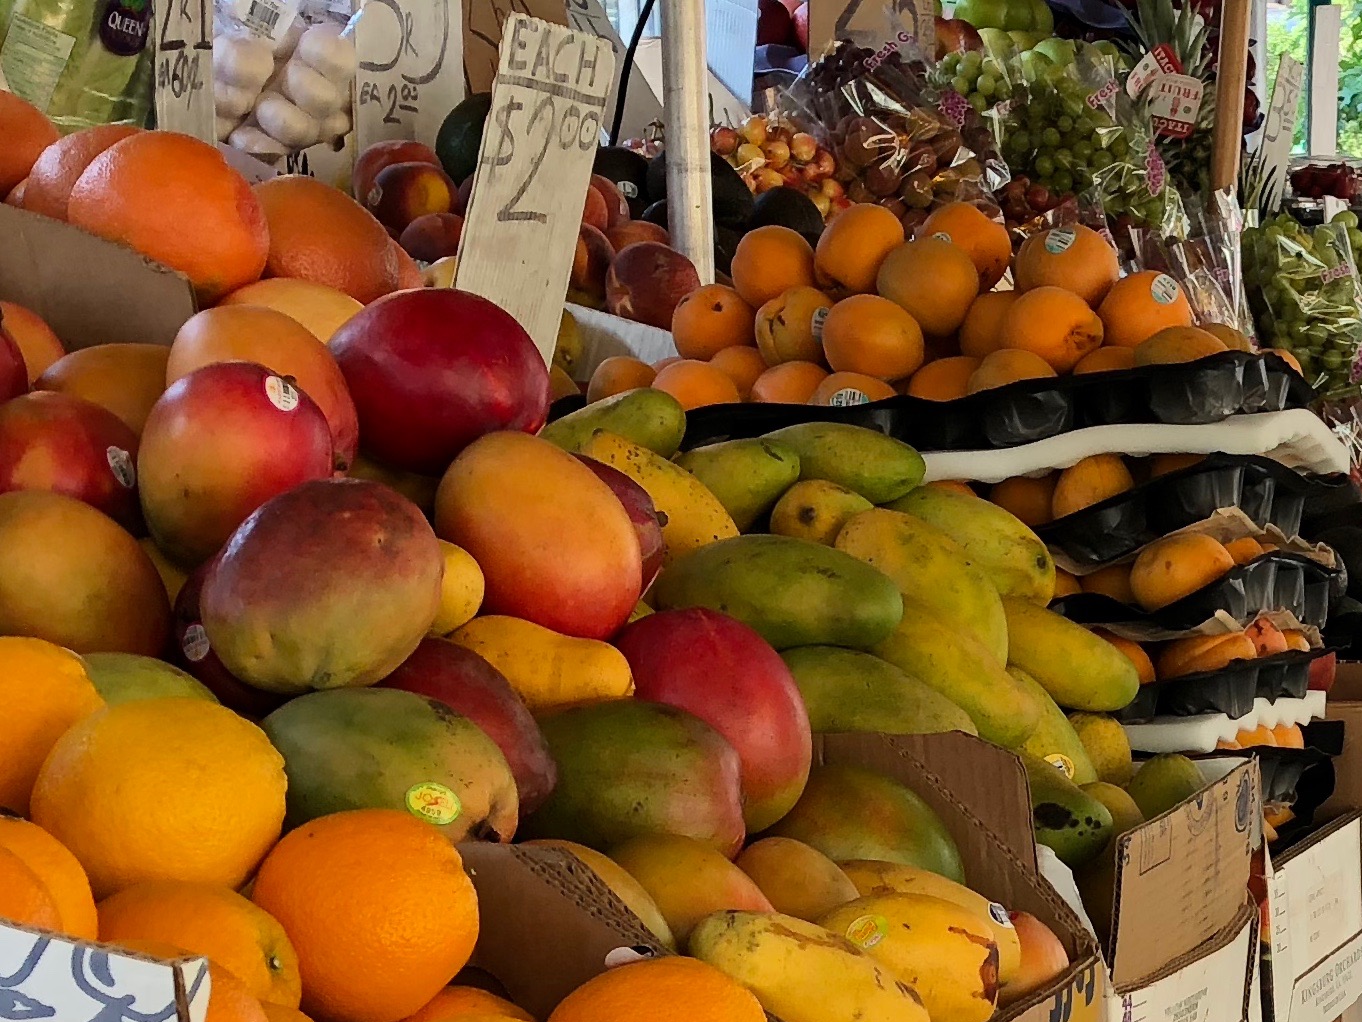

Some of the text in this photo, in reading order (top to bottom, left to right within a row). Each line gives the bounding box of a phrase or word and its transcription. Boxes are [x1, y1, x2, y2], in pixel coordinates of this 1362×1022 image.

[108, 11, 143, 37] QUEEN
[507, 18, 600, 87] EACH
[1159, 82, 1200, 101] FRUIT
